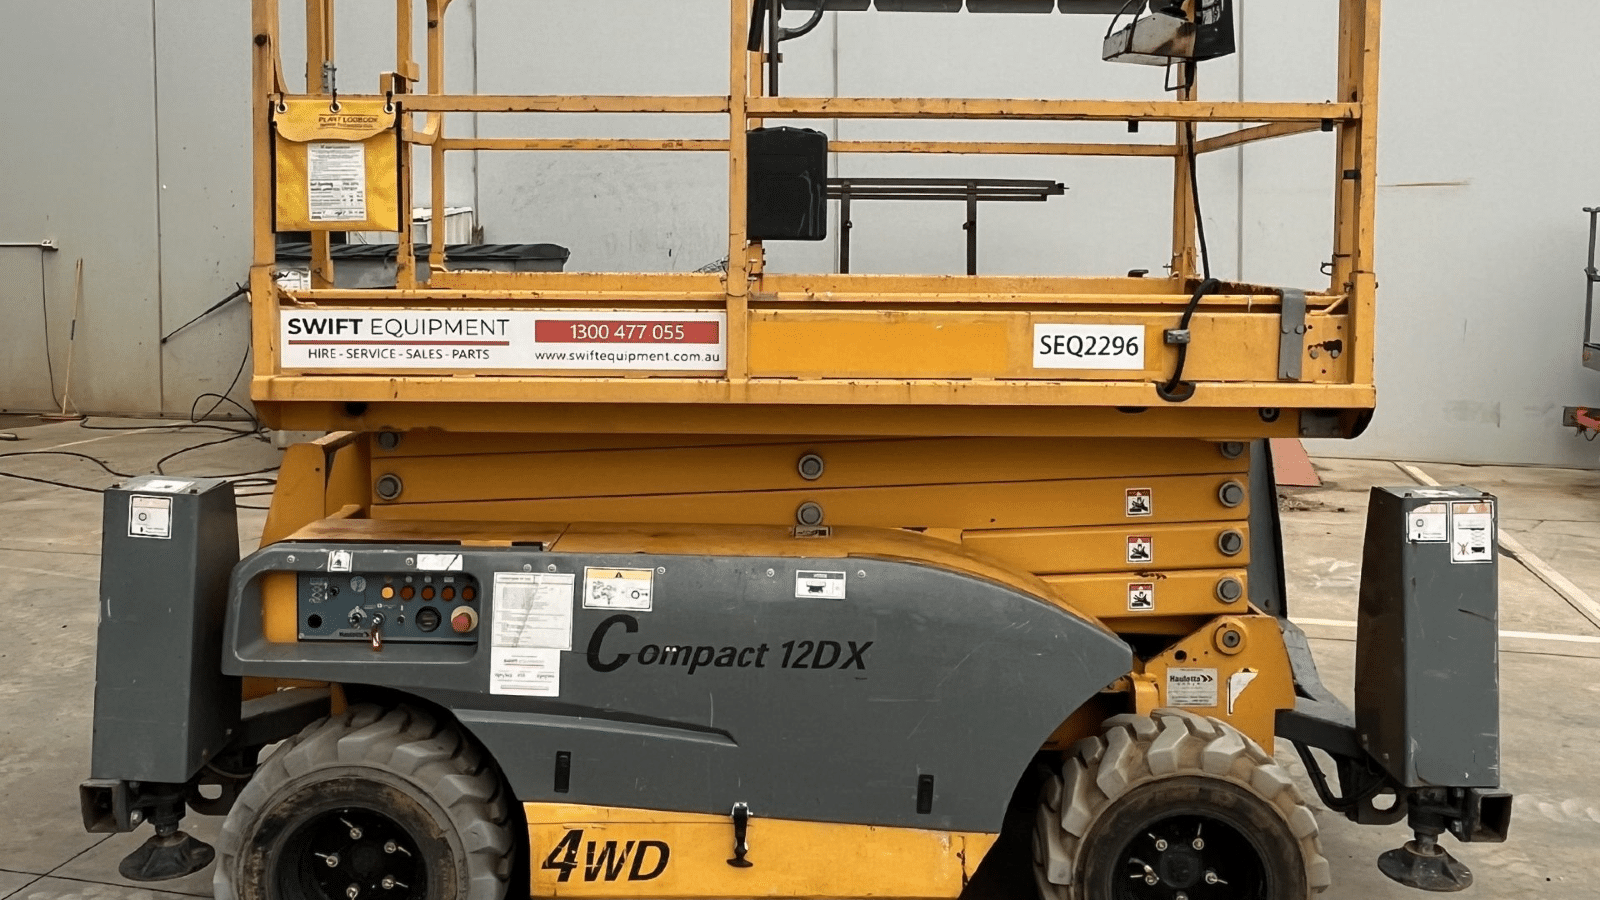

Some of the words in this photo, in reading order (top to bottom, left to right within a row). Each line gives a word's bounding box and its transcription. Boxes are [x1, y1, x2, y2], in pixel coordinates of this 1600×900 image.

[288, 318, 363, 335] SWIFT
[371, 318, 510, 338] EQUIPMENT
[570, 324, 609, 339] 1300
[614, 324, 647, 339] 477
[652, 324, 685, 340] 055
[308, 348, 336, 359] HIRE
[346, 348, 396, 359] SERVICE
[406, 349, 443, 359] SALES
[452, 349, 490, 360] PARTS
[1039, 334, 1139, 357] SEQ2296
[535, 350, 720, 363] www.swiftequipment.com.au
[586, 614, 770, 675] Compact
[780, 640, 874, 670] 12DX
[541, 829, 670, 882] 4WD
